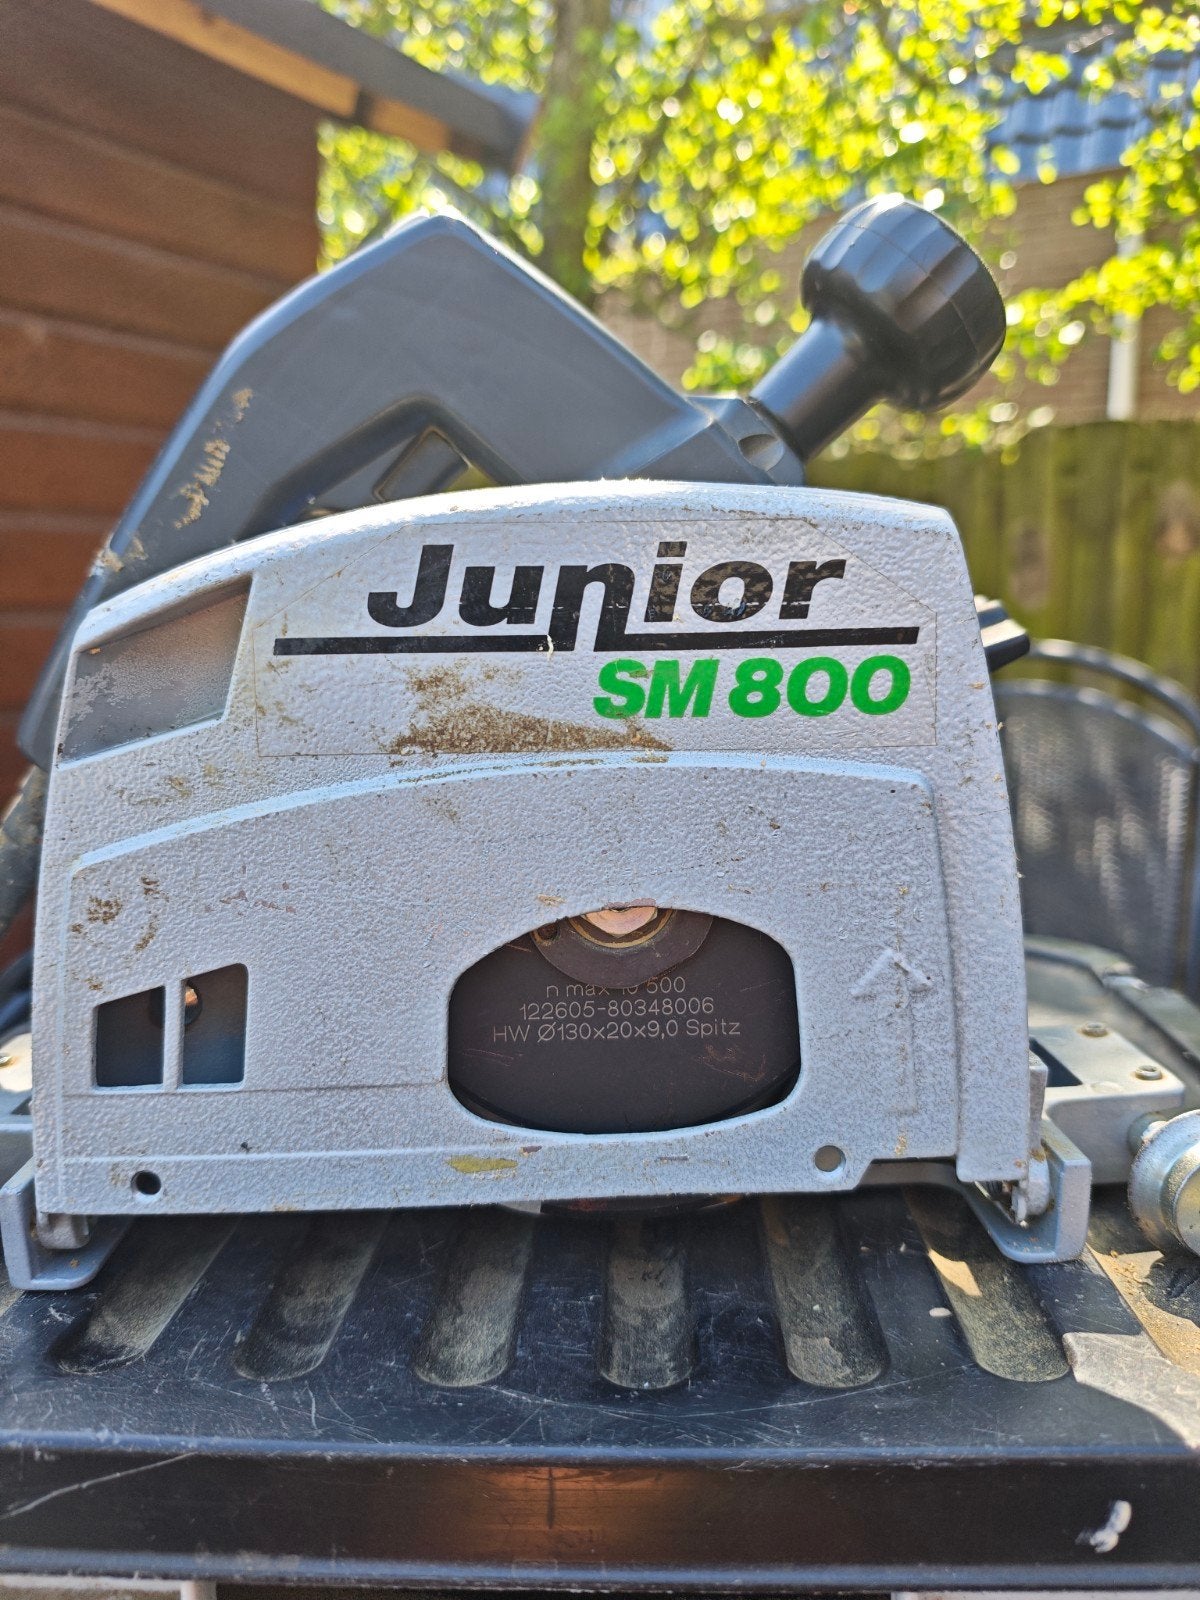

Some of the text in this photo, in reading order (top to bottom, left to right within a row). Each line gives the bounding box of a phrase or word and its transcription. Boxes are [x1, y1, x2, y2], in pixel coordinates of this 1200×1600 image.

[367, 540, 847, 651] Junior
[593, 655, 911, 719] SM 800
[546, 983, 559, 998] n
[566, 982, 610, 998] max
[519, 997, 715, 1021] 122605-80348006
[492, 1025, 530, 1043] HW
[686, 1018, 741, 1038] Spitz
